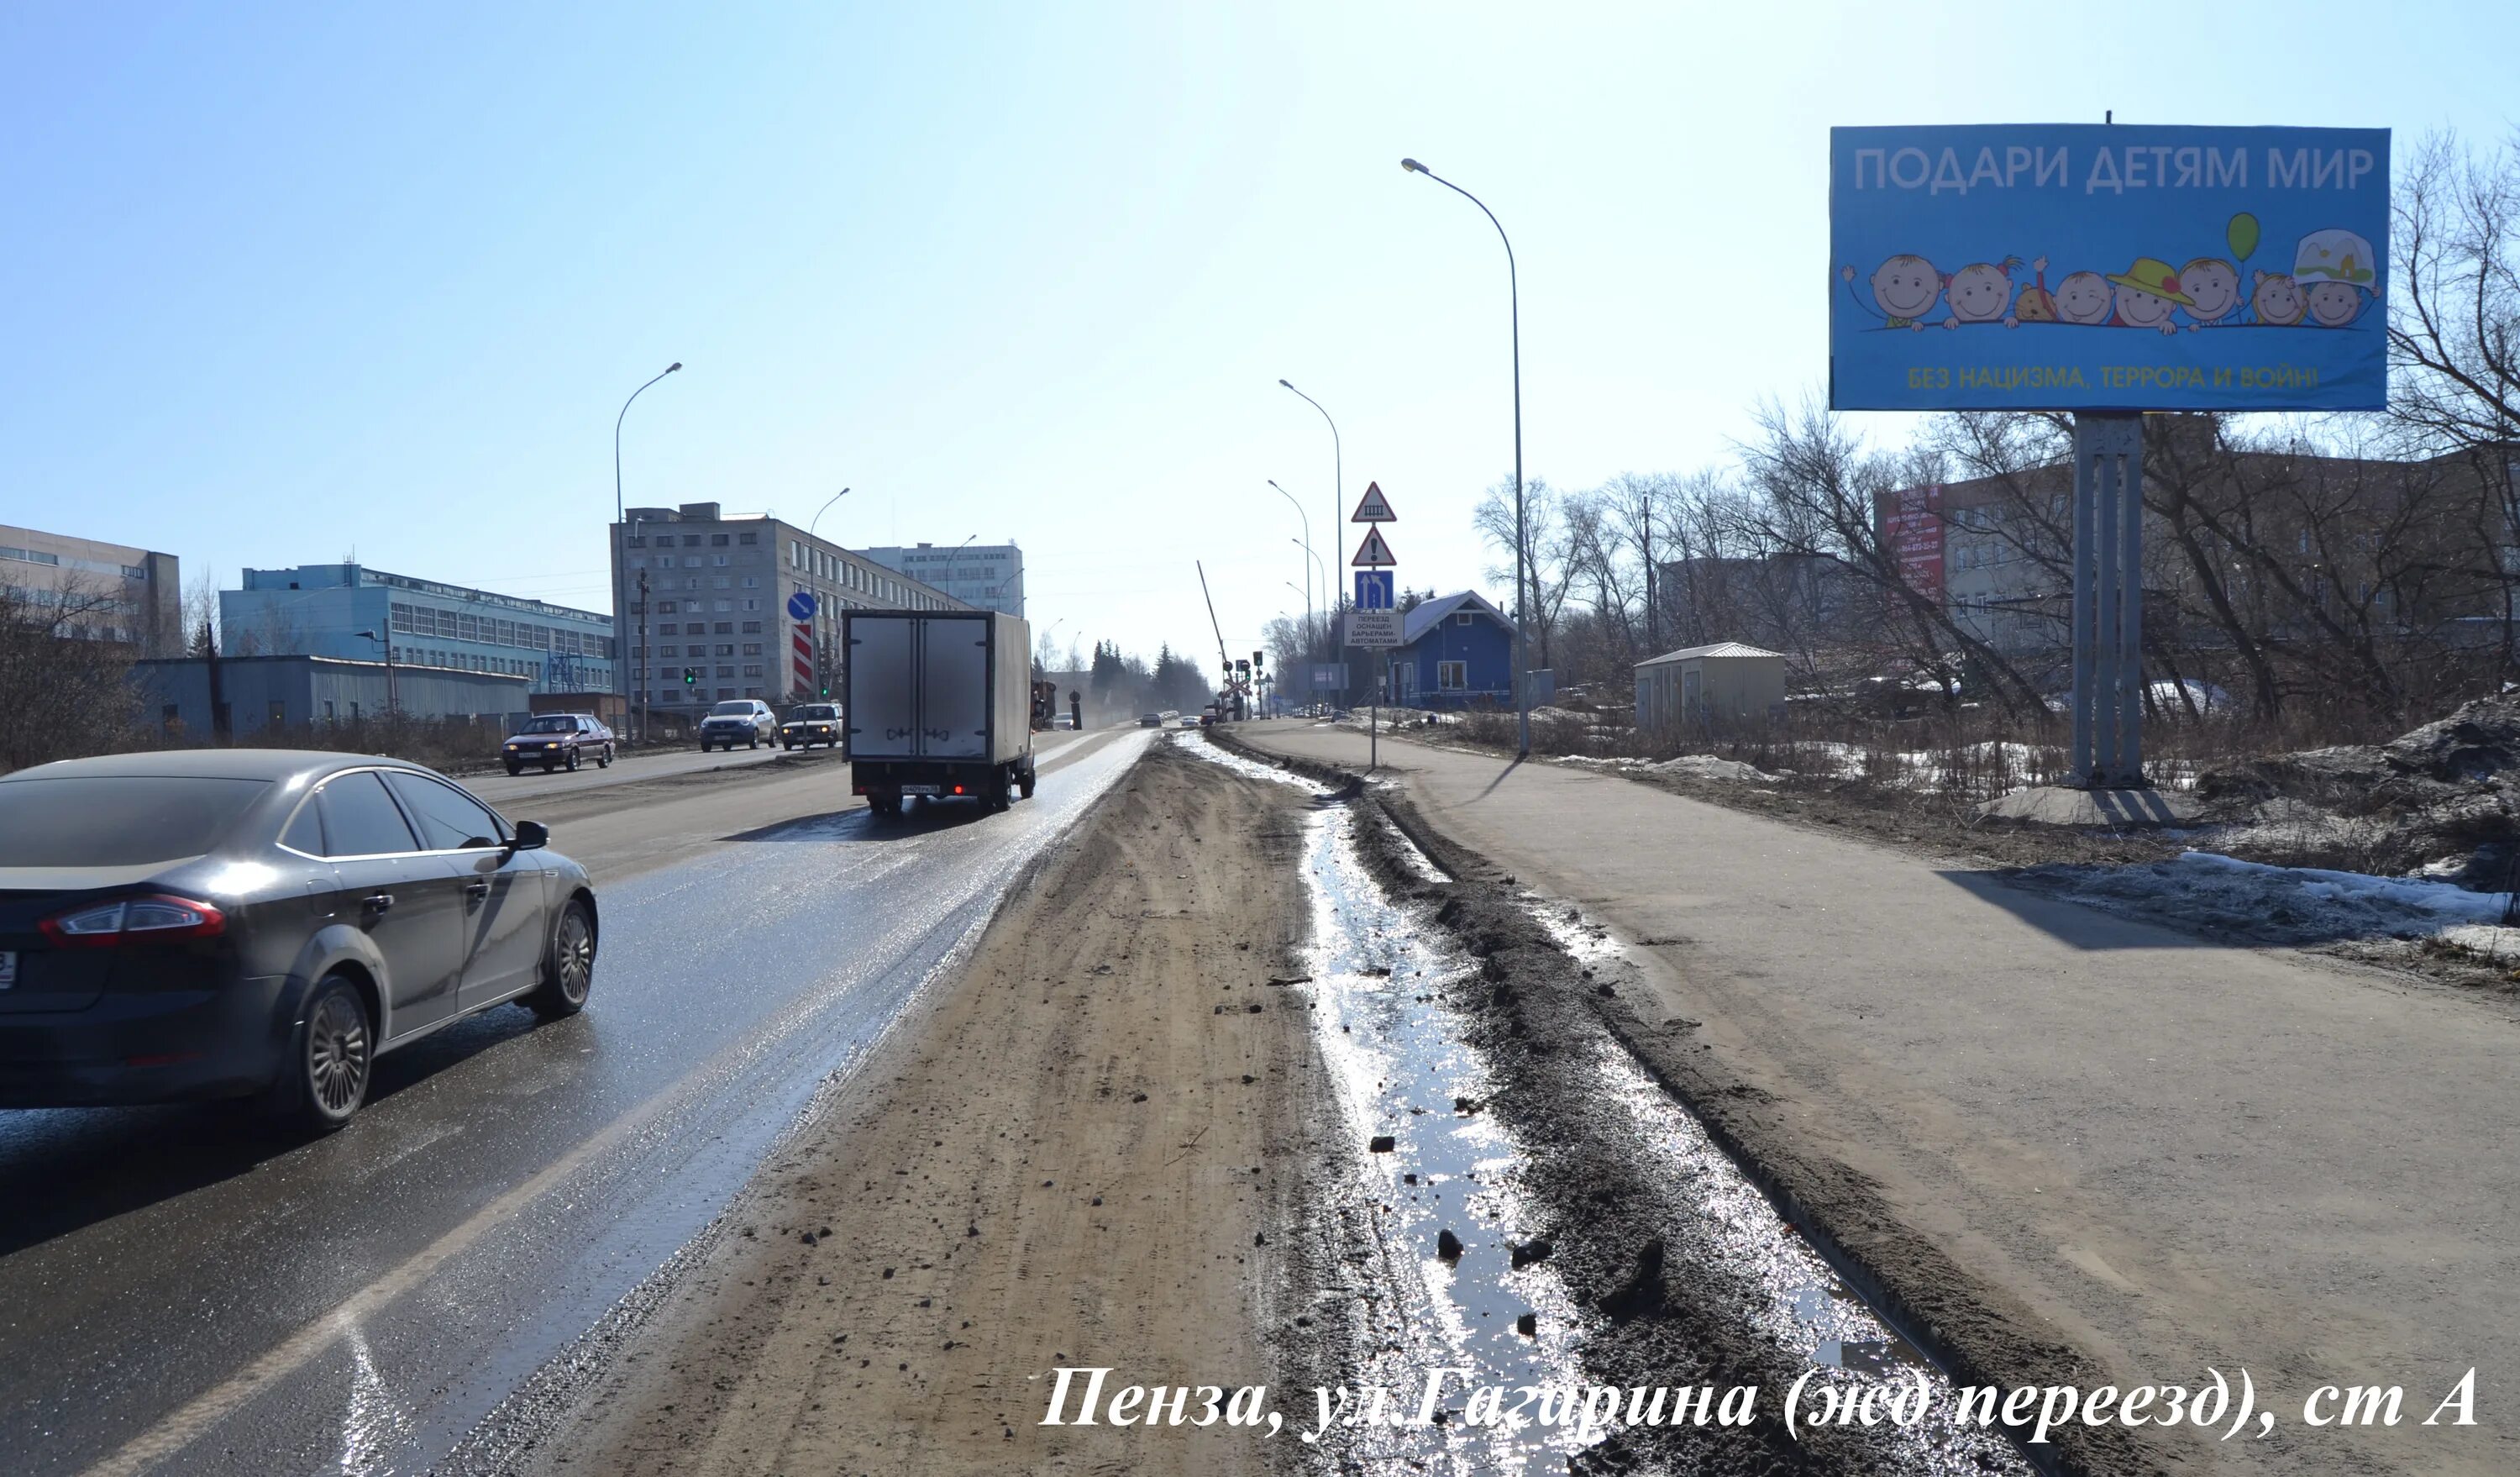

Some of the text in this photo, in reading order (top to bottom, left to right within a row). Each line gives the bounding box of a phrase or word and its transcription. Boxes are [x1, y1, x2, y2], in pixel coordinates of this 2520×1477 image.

[1855, 145, 2375, 195] ПОДАРИ ДЕТЯМ МИР
[1908, 363, 2319, 392] БЕЗ НАЦИЗМА, ТЕРРОРА И ВОЙН!
